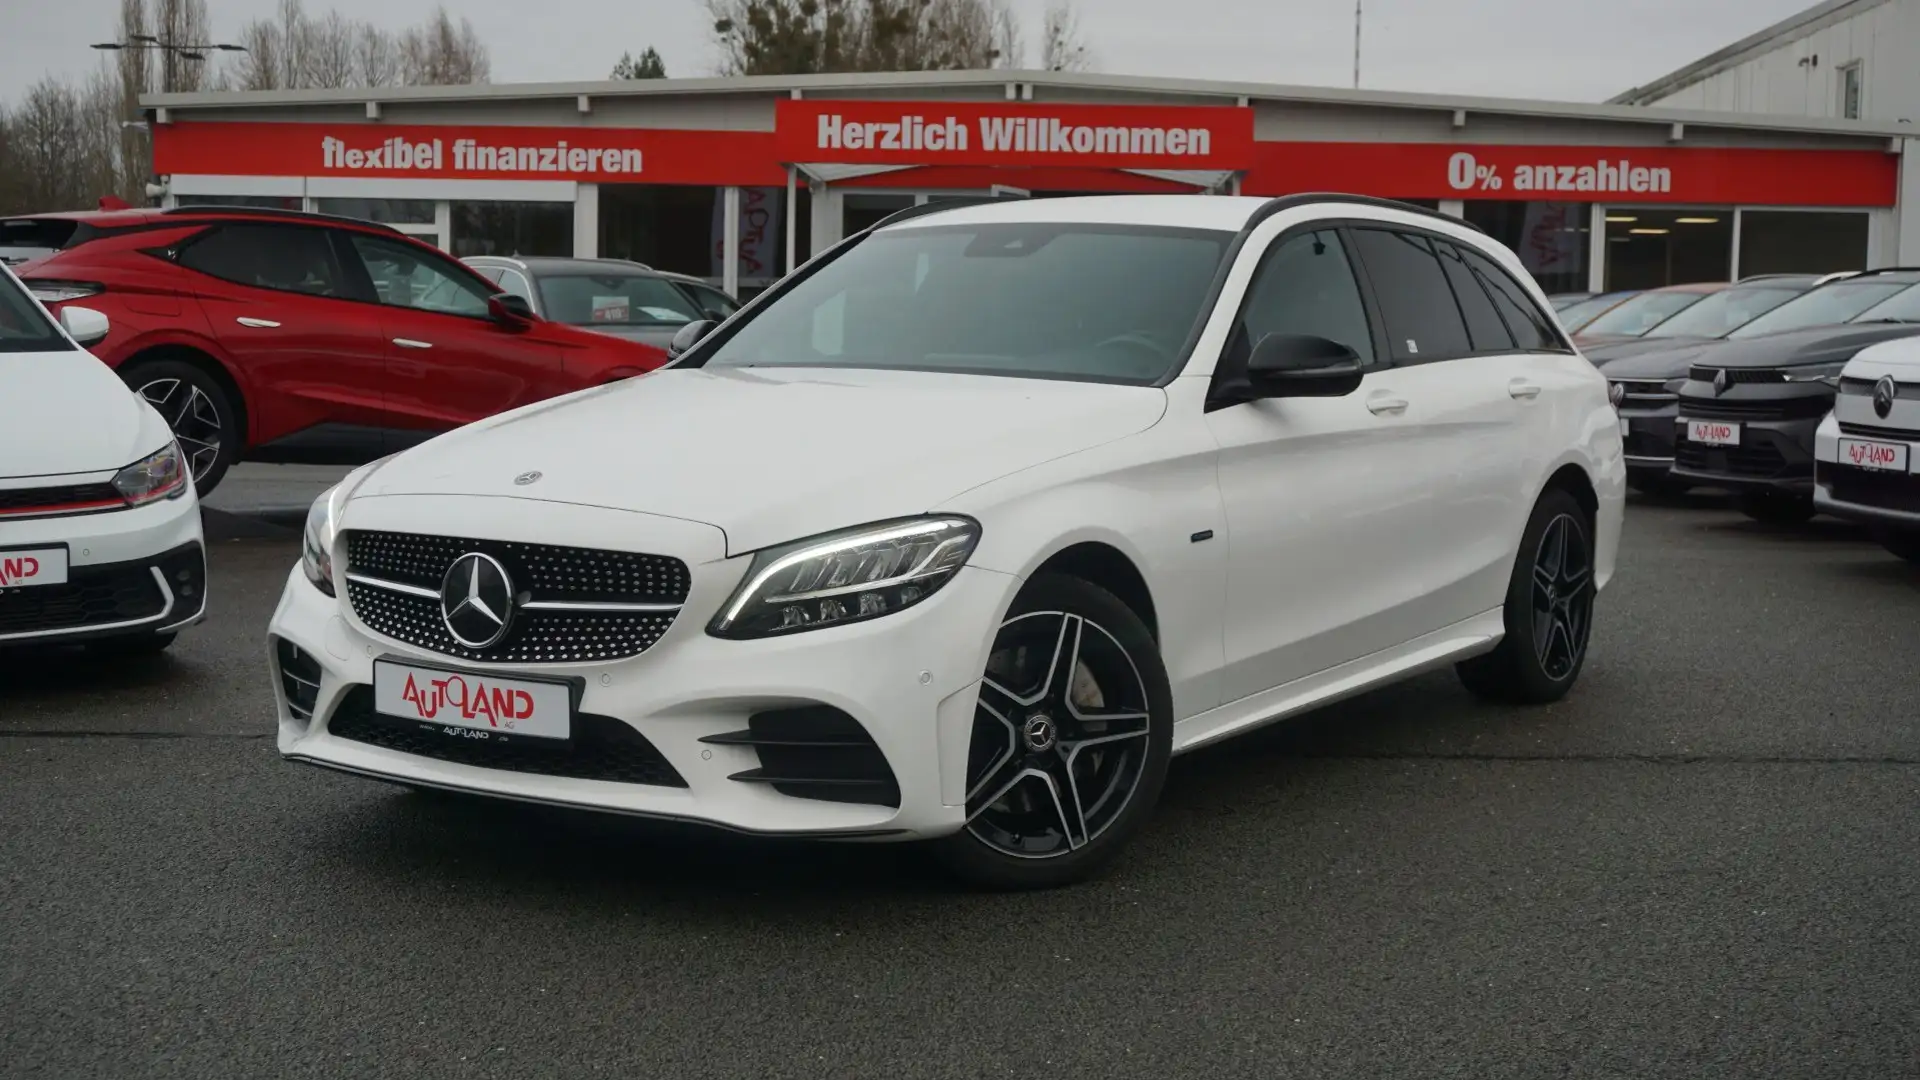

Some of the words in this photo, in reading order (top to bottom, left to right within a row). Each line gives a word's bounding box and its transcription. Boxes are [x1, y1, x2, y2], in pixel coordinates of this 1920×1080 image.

[322, 135, 443, 170] flexibel
[452, 138, 643, 173] finanzieren
[817, 114, 968, 151] Herzlich
[979, 116, 1211, 155] Willkommen
[1448, 152, 1503, 190] 0%
[1513, 159, 1672, 193] anzahlen
[402, 671, 535, 728] AUTOLAND
[443, 726, 490, 740] AUTOLAND
